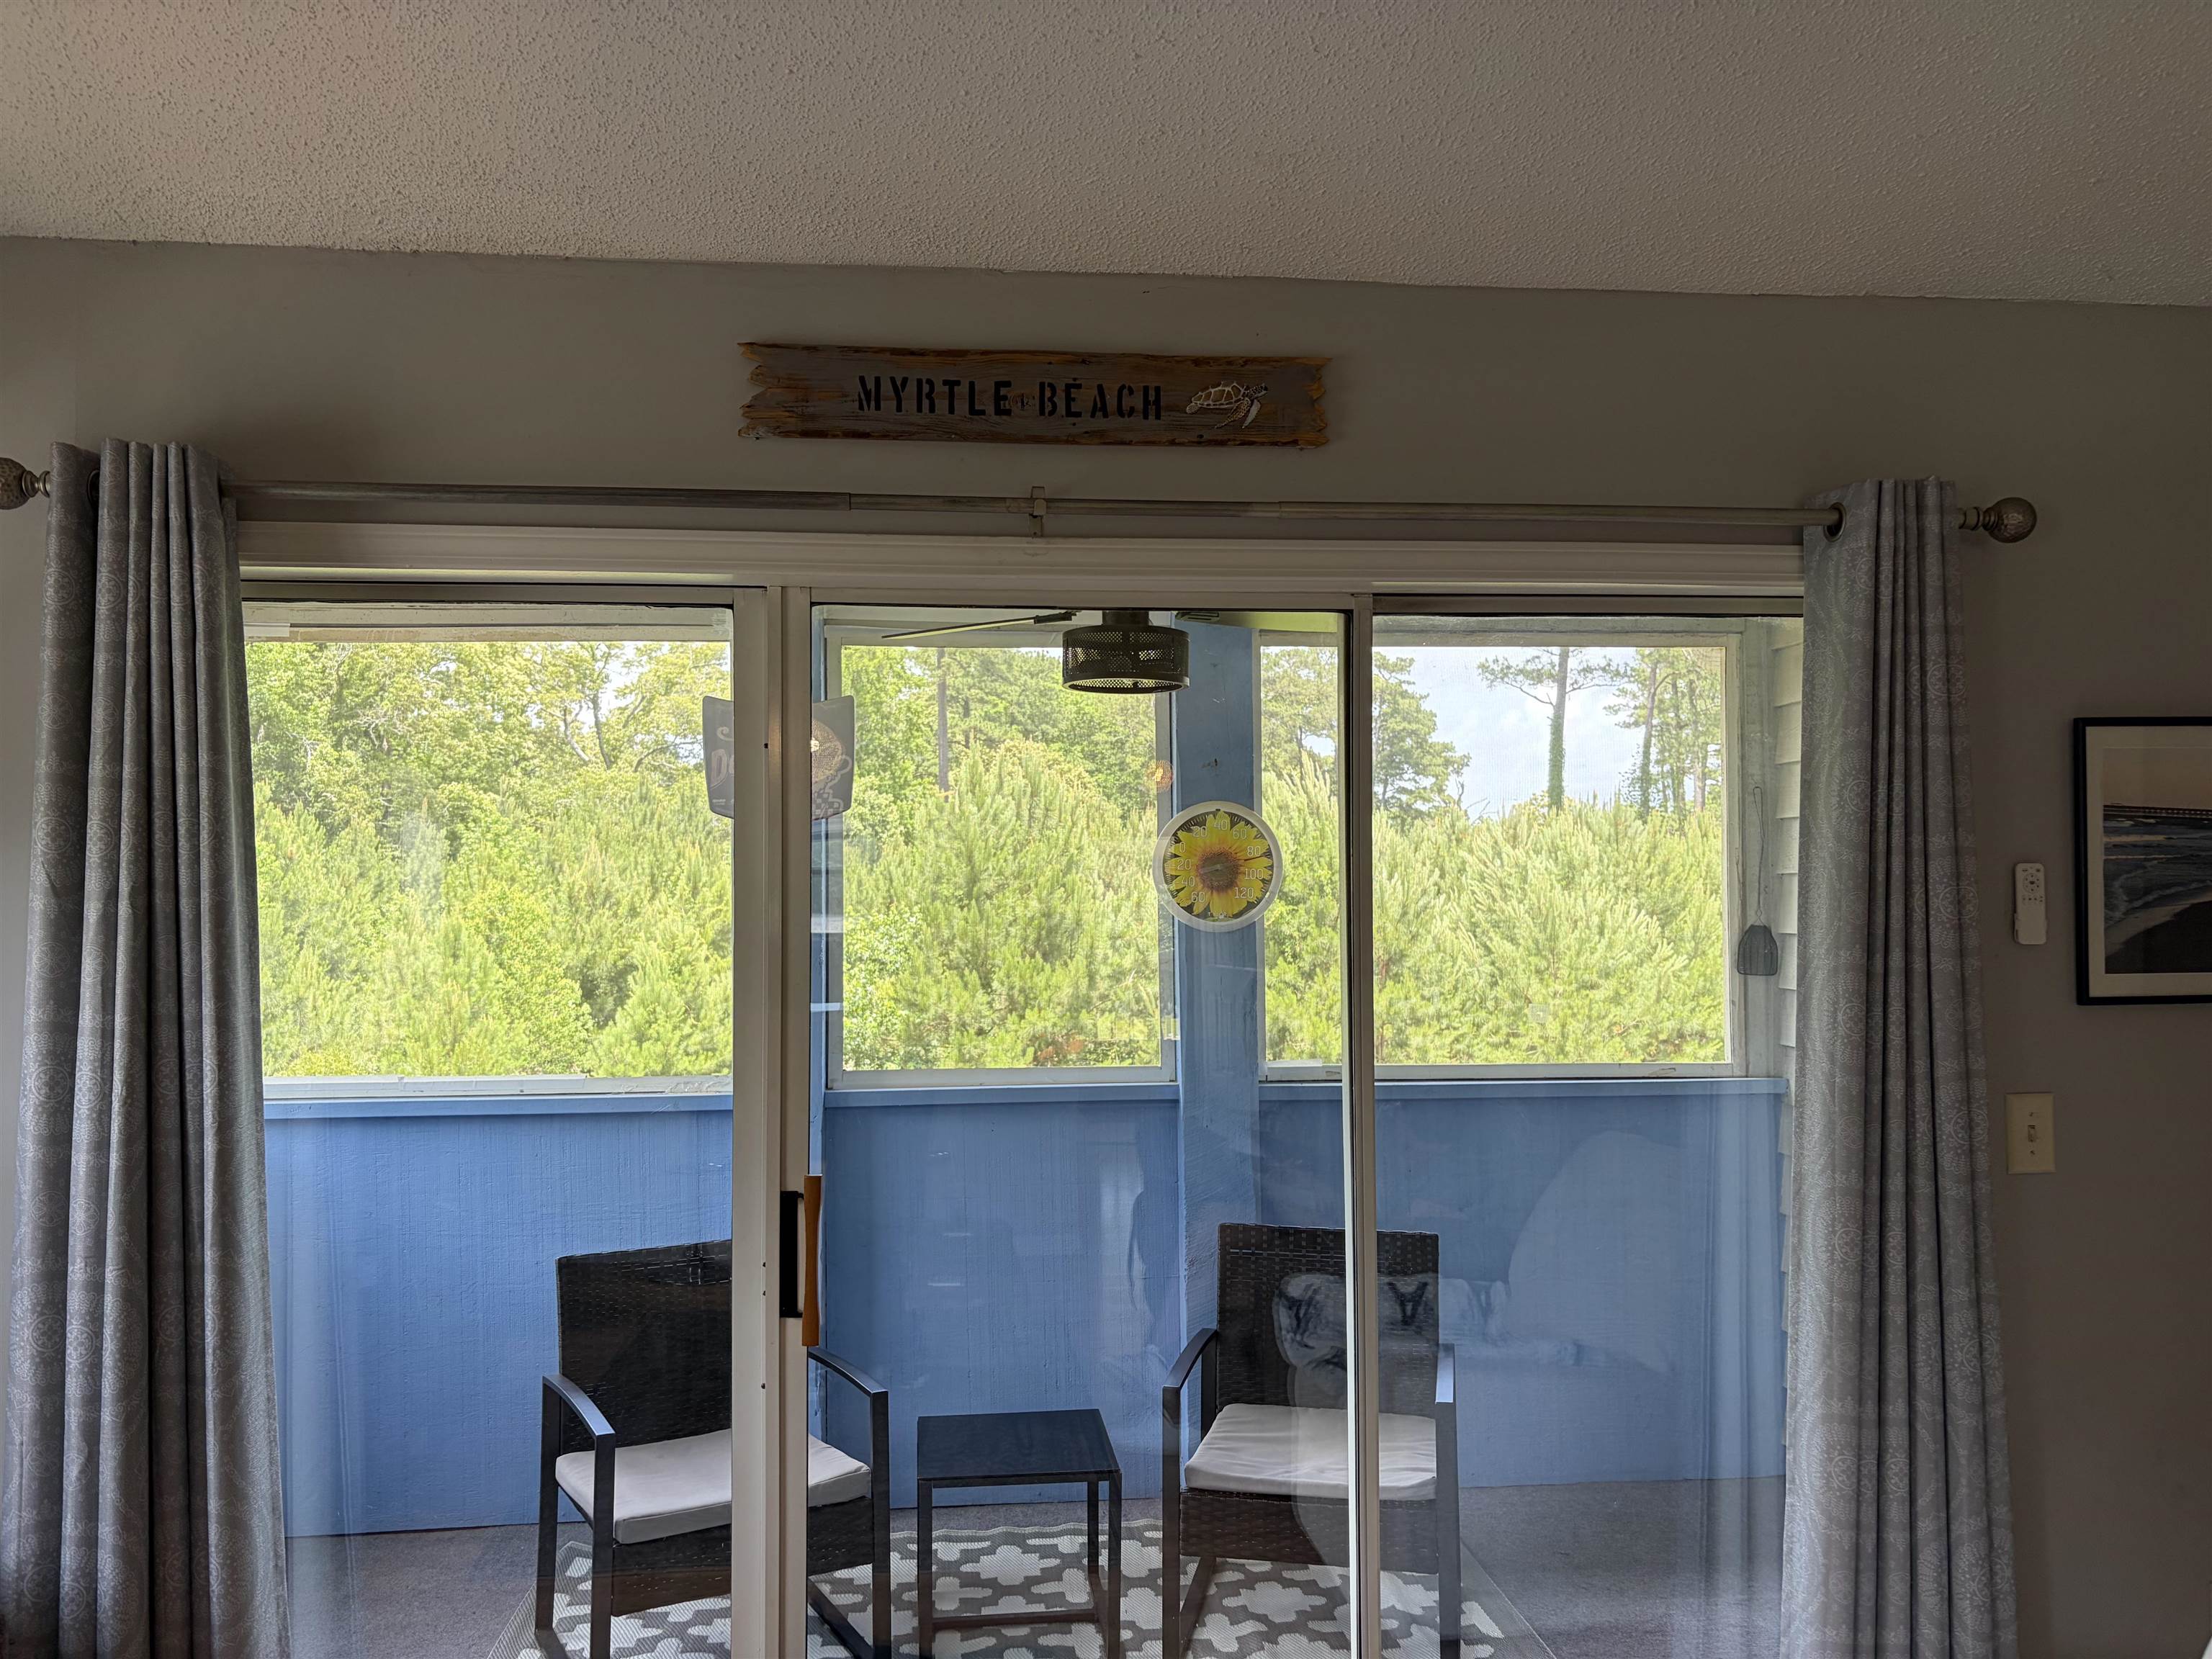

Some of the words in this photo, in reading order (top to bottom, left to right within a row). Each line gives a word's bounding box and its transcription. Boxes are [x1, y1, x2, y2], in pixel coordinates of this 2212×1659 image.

[858, 375, 1012, 416] MYRTLE
[1038, 379, 1161, 421] BEACH
[1214, 819, 1228, 831] 40
[1192, 826, 1208, 837] 20
[1233, 829, 1247, 840] 60
[1179, 842, 1186, 853] 0
[1247, 846, 1262, 857] 80
[1244, 868, 1264, 880] 100
[1234, 887, 1254, 899] 120
